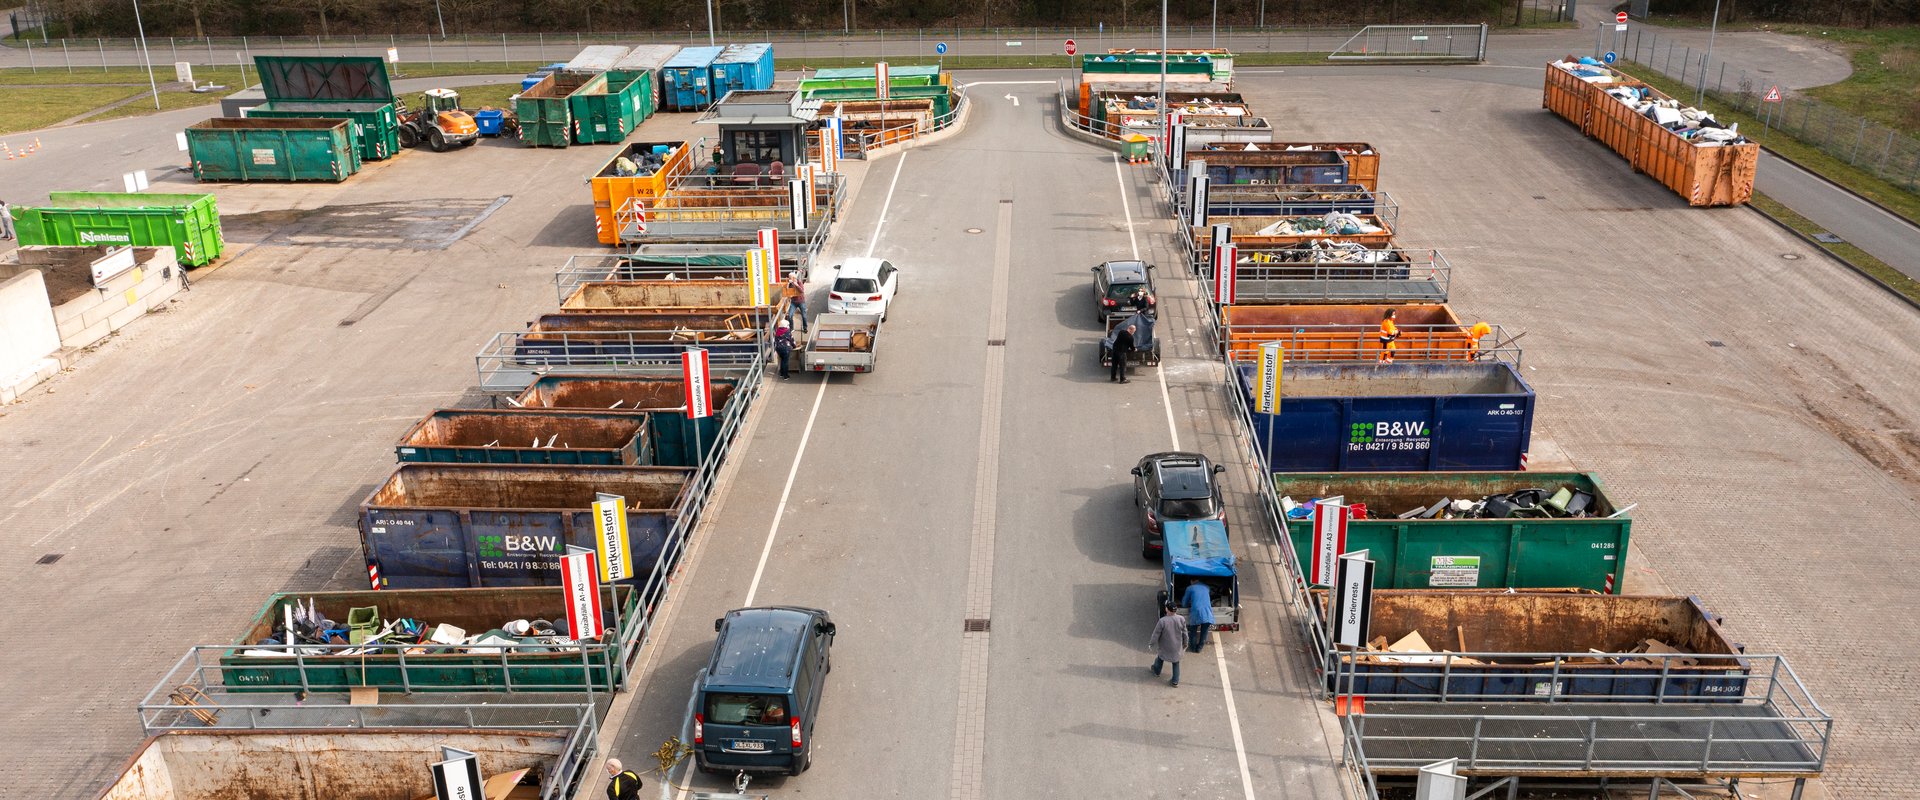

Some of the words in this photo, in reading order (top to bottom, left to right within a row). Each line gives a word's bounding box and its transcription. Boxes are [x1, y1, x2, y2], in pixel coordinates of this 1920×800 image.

[80, 231, 130, 243] Nehlsen
[694, 376, 700, 384] A4
[1263, 354, 1273, 413] Hartkunststoff
[1349, 443, 1363, 451] Tel:
[1398, 442, 1414, 450] 850
[1415, 442, 1430, 450] 860
[603, 509, 619, 580] Hartkunststoff
[482, 561, 497, 569] Tel:
[498, 561, 518, 569] 0421
[549, 562, 561, 570] 86
[1323, 551, 1331, 584] Holzabfälle
[580, 602, 590, 637] Holzabfälle
[1348, 582, 1359, 625] Sortierreste
